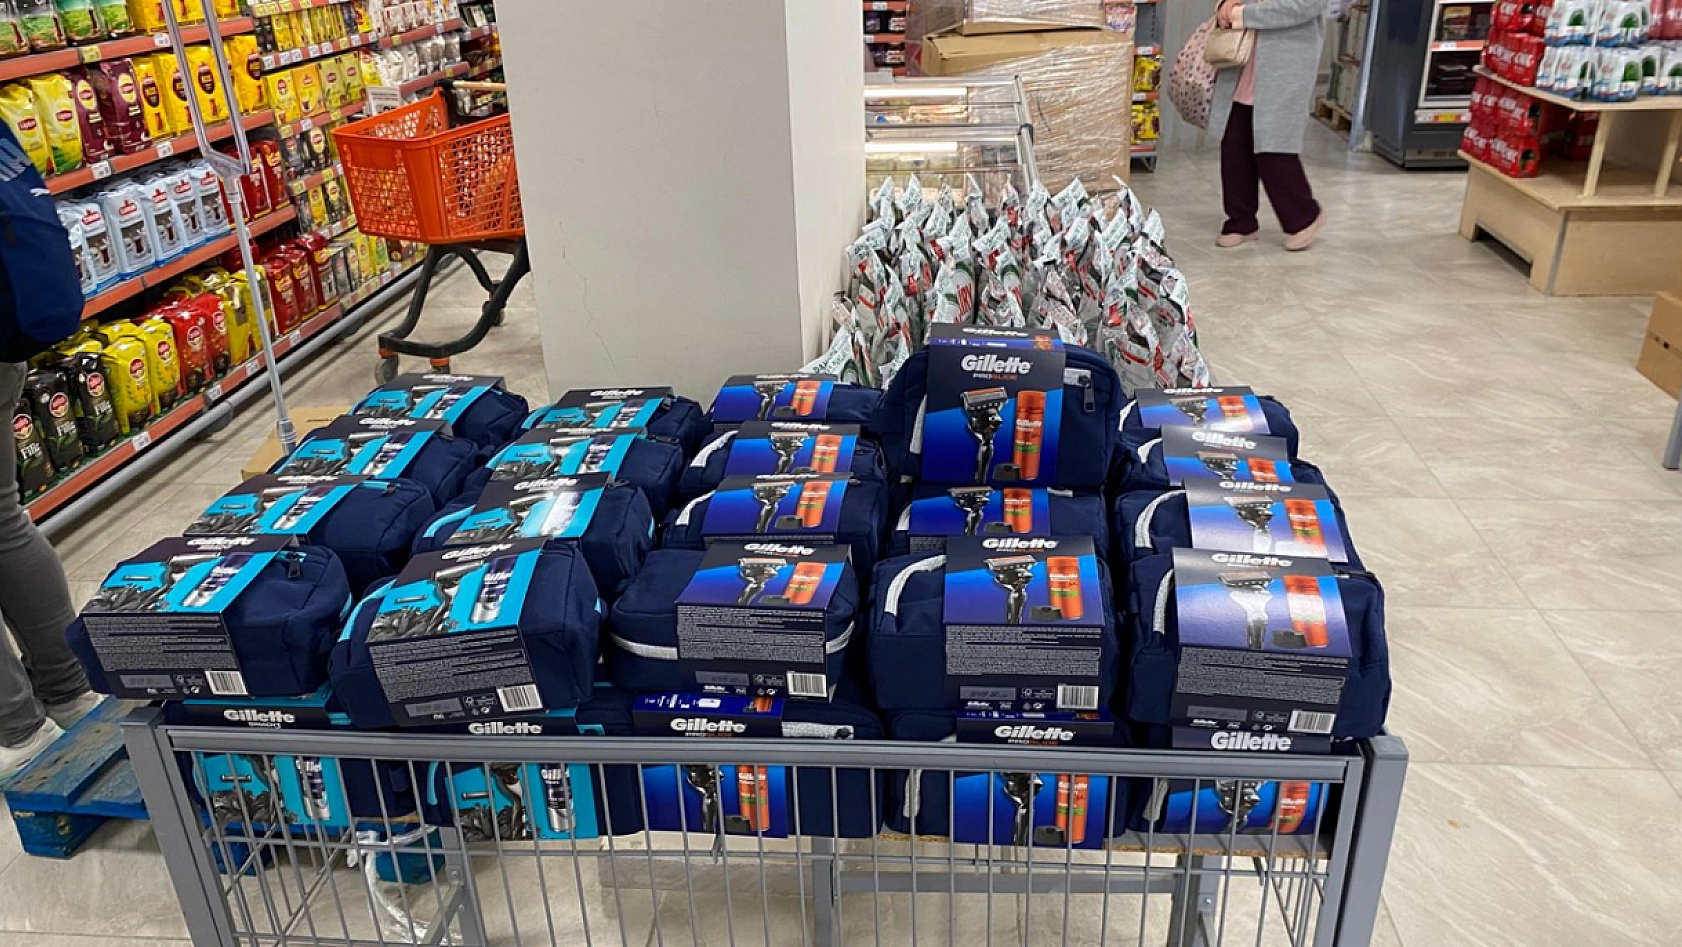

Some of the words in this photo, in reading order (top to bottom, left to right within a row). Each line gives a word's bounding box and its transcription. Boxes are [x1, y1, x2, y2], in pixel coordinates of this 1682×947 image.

[961, 354, 1033, 375] Gillette
[1191, 431, 1256, 450] Gillette
[1219, 480, 1293, 492] Gillette
[743, 543, 817, 556] Gillette
[982, 537, 1058, 549] Gillette
[1211, 553, 1293, 567] Gillette
[223, 708, 296, 723] Gillette
[468, 721, 544, 735] Gillette
[670, 717, 748, 733] Gillette
[994, 725, 1075, 741] Gillette
[1210, 731, 1293, 751] Gillette
